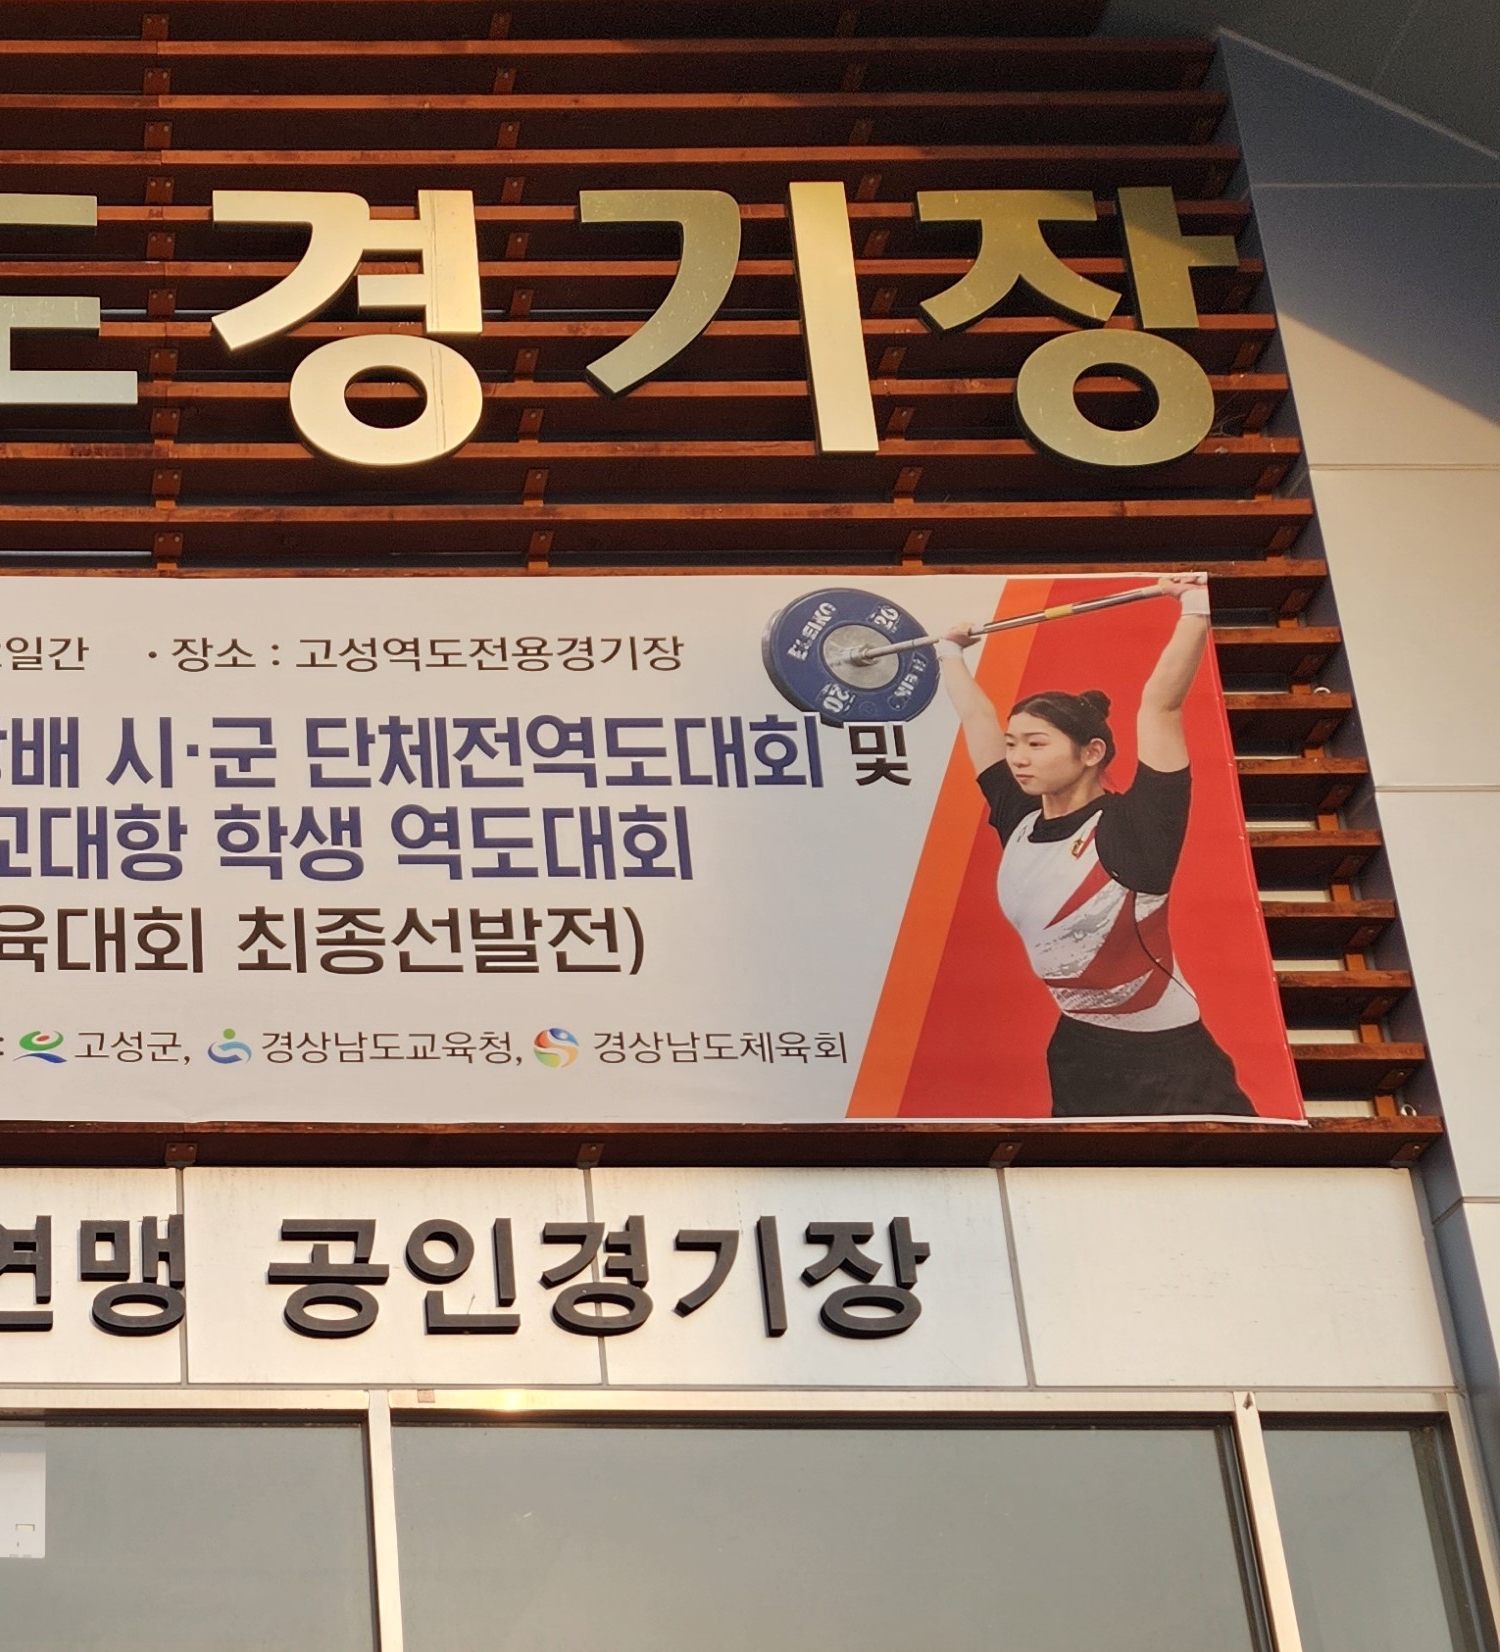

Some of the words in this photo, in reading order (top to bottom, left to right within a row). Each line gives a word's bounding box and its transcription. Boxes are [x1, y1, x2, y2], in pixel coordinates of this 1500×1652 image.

[170, 636, 257, 673] 장소
[295, 635, 685, 673] 고성역도전용경기장
[105, 714, 278, 790] 시·군
[304, 713, 825, 790] 단체전역도대회
[848, 723, 913, 787] 및
[215, 802, 366, 883] 학생
[390, 802, 694, 883] 역도대회
[236, 904, 646, 977] 최종선발전)
[73, 1028, 192, 1067] 고성군,
[260, 1030, 523, 1068] 경상남도교육청,
[592, 1030, 849, 1065] 경상남도체육회
[267, 1214, 931, 1341] 공인경기장
